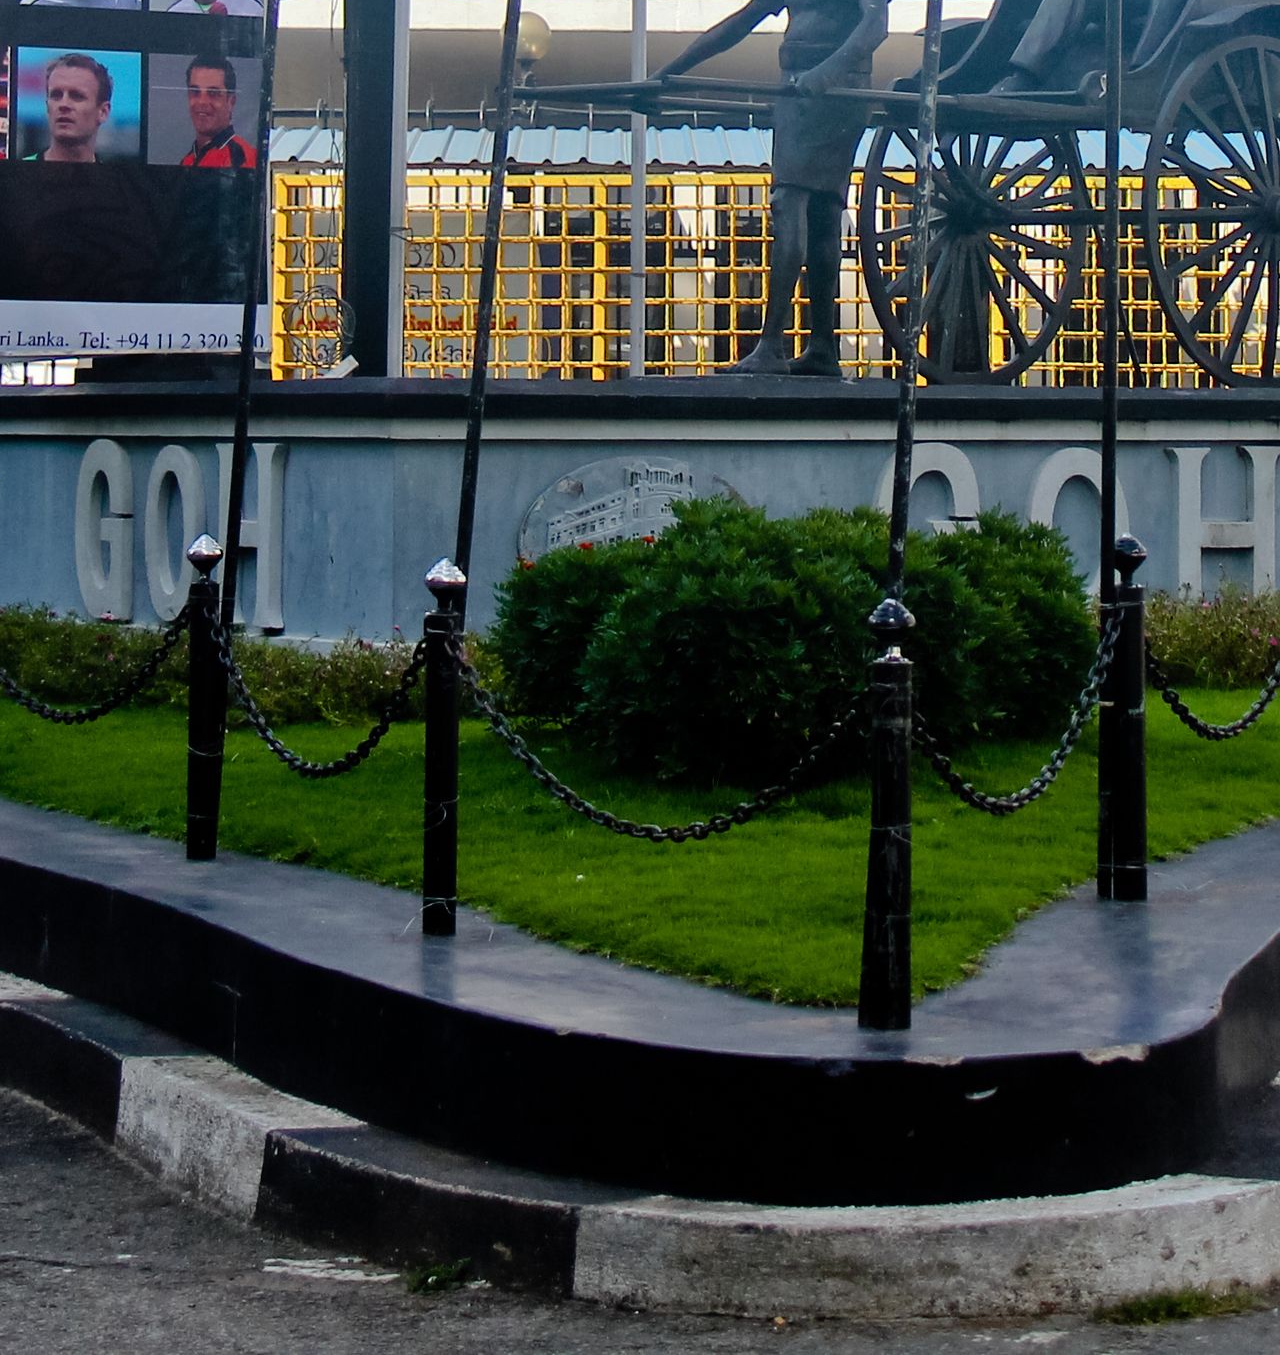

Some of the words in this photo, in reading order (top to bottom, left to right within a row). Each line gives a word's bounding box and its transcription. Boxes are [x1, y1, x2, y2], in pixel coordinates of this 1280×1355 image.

[16, 331, 69, 347] Lanka.
[78, 331, 111, 350] Tel:
[116, 333, 148, 350] +94
[156, 333, 173, 350] 11
[180, 333, 191, 350] 2
[198, 333, 228, 350] 320
[234, 333, 264, 350] 30
[75, 438, 287, 630] GOH
